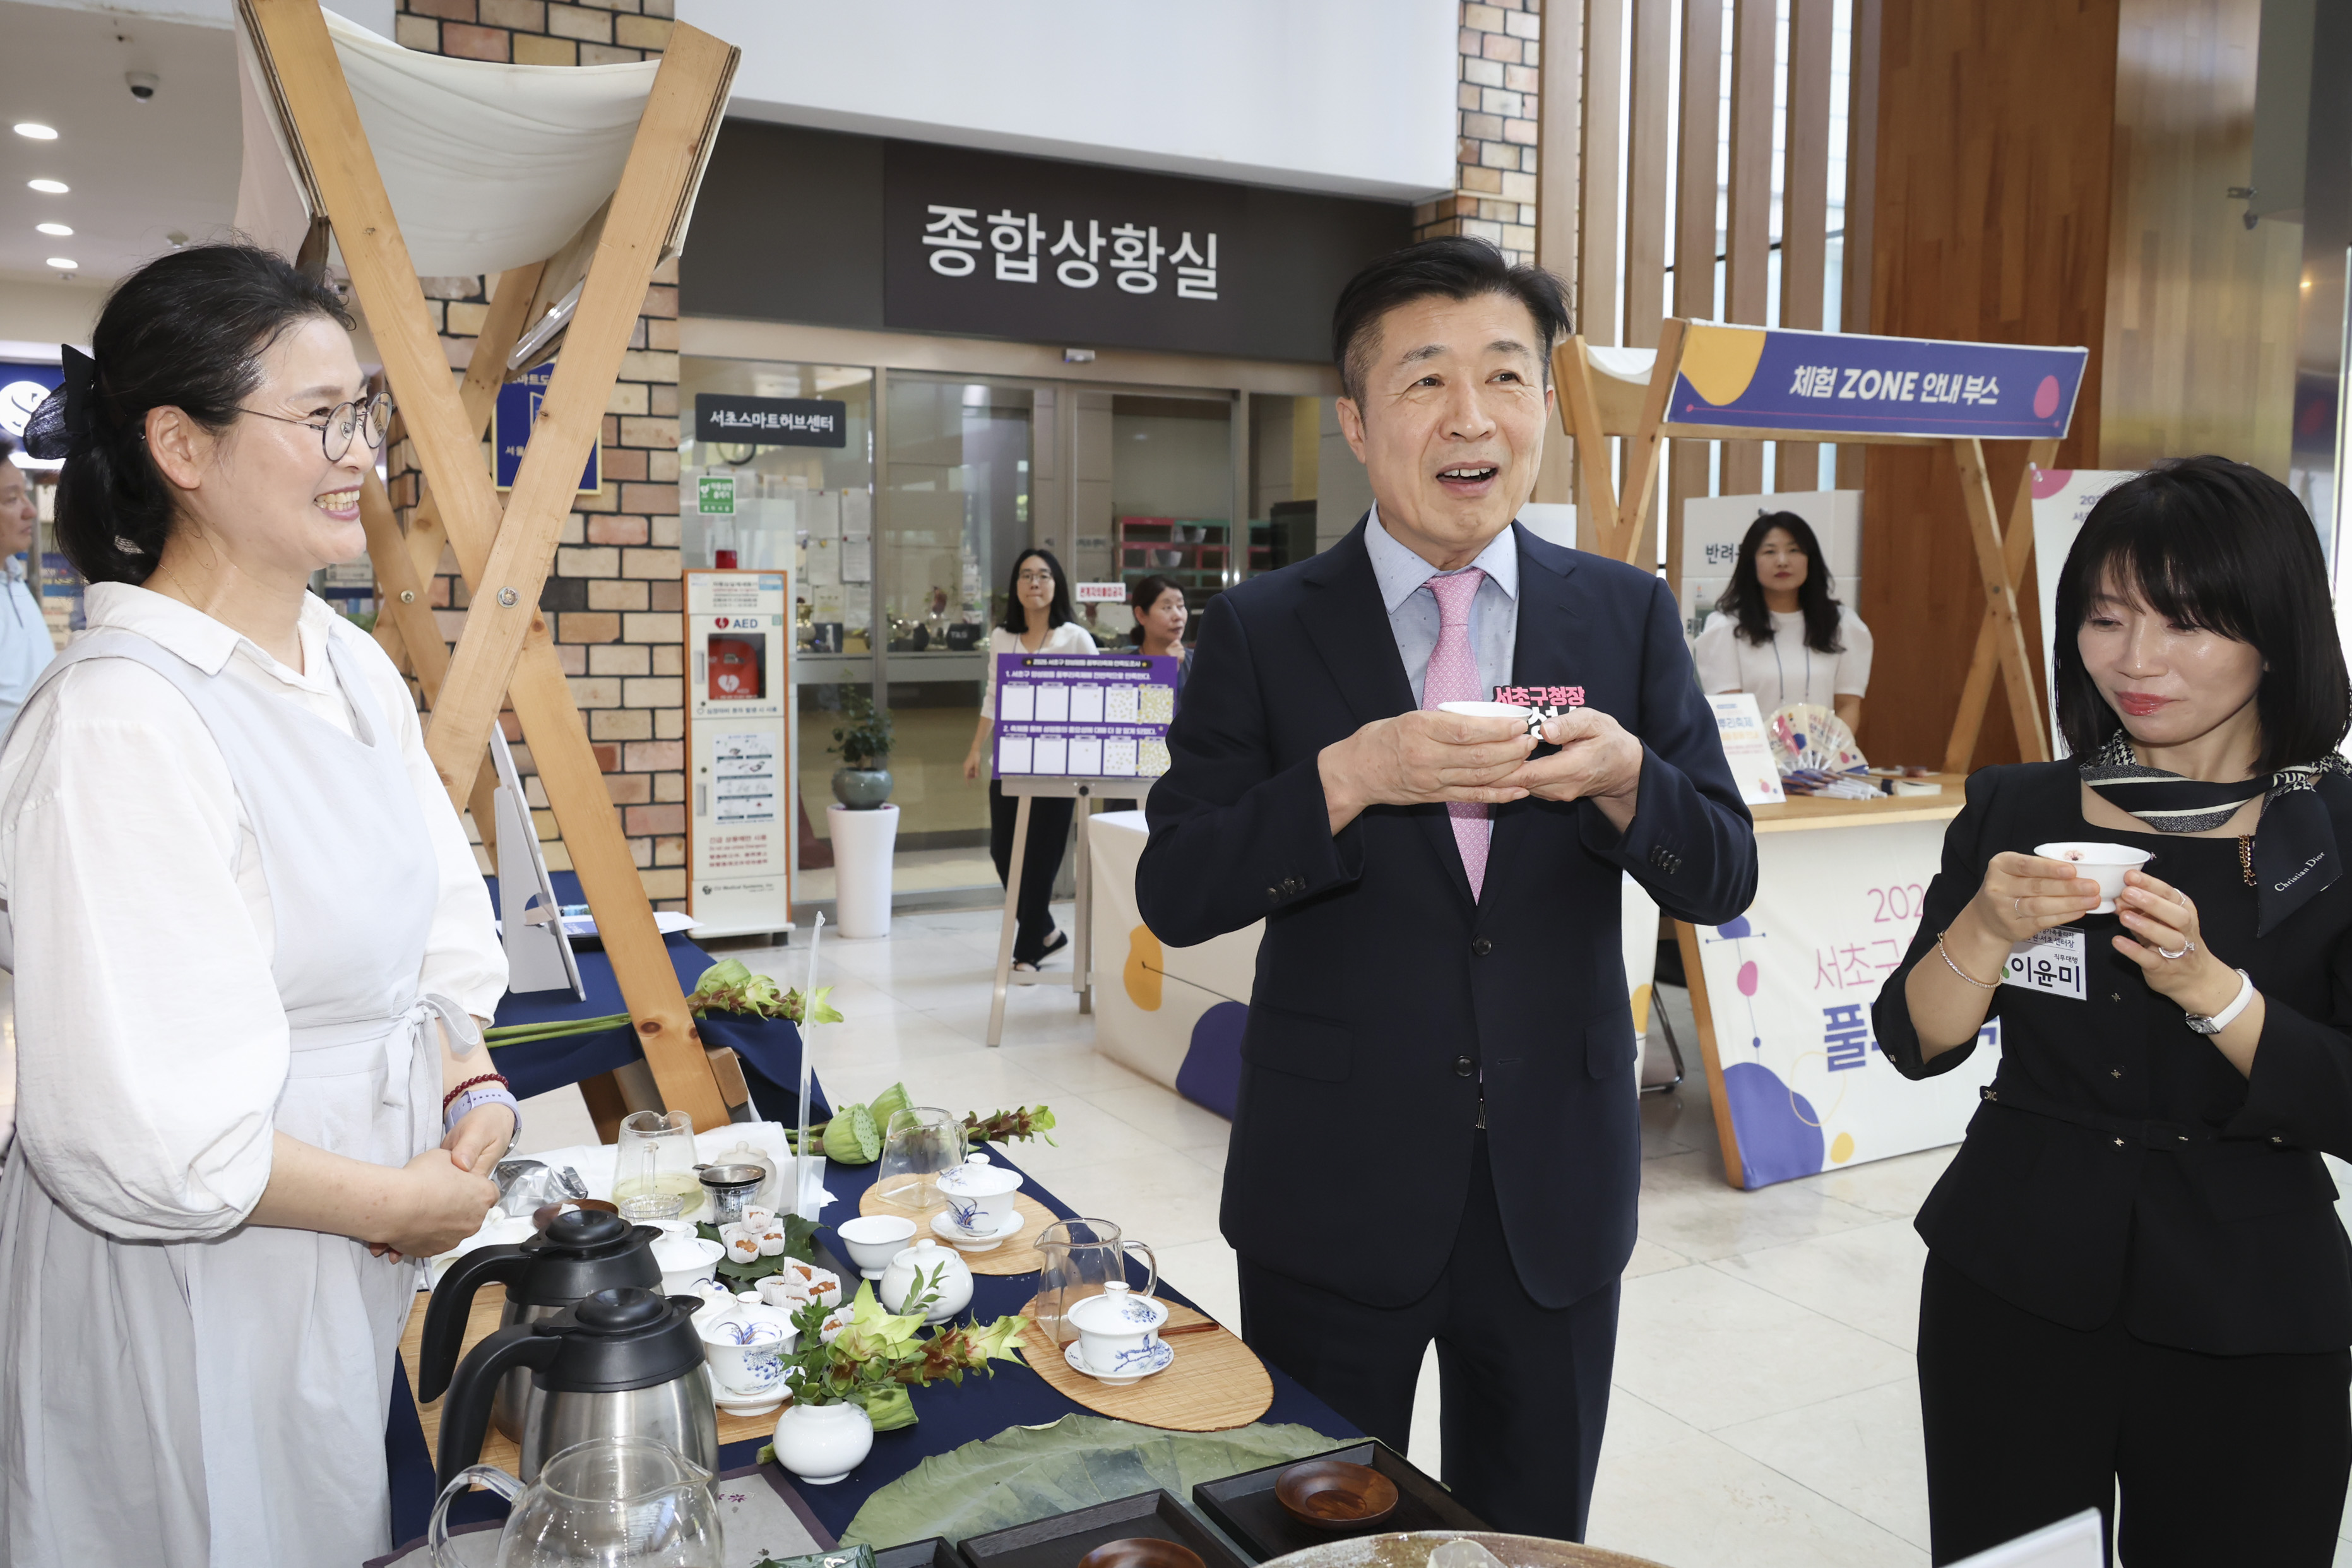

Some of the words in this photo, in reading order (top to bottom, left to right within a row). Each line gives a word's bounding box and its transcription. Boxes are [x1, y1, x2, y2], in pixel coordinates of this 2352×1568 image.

[922, 205, 1218, 300] 종합상황실
[1789, 365, 1838, 398] 체험
[1838, 368, 1920, 400] ZONE
[1920, 372, 1963, 404] 안내
[1962, 375, 2000, 405] 부스
[710, 410, 834, 432] 서초스마트허브센터
[734, 619, 758, 629] AED
[1495, 686, 1585, 706] 서초구청장
[2274, 867, 2310, 891] Christian
[2305, 852, 2325, 868] Dior
[2028, 934, 2075, 947] 원·서초센터장
[1814, 939, 1903, 990] 서초구
[2054, 954, 2078, 964] 직무대행
[2011, 956, 2080, 993] 이윤미
